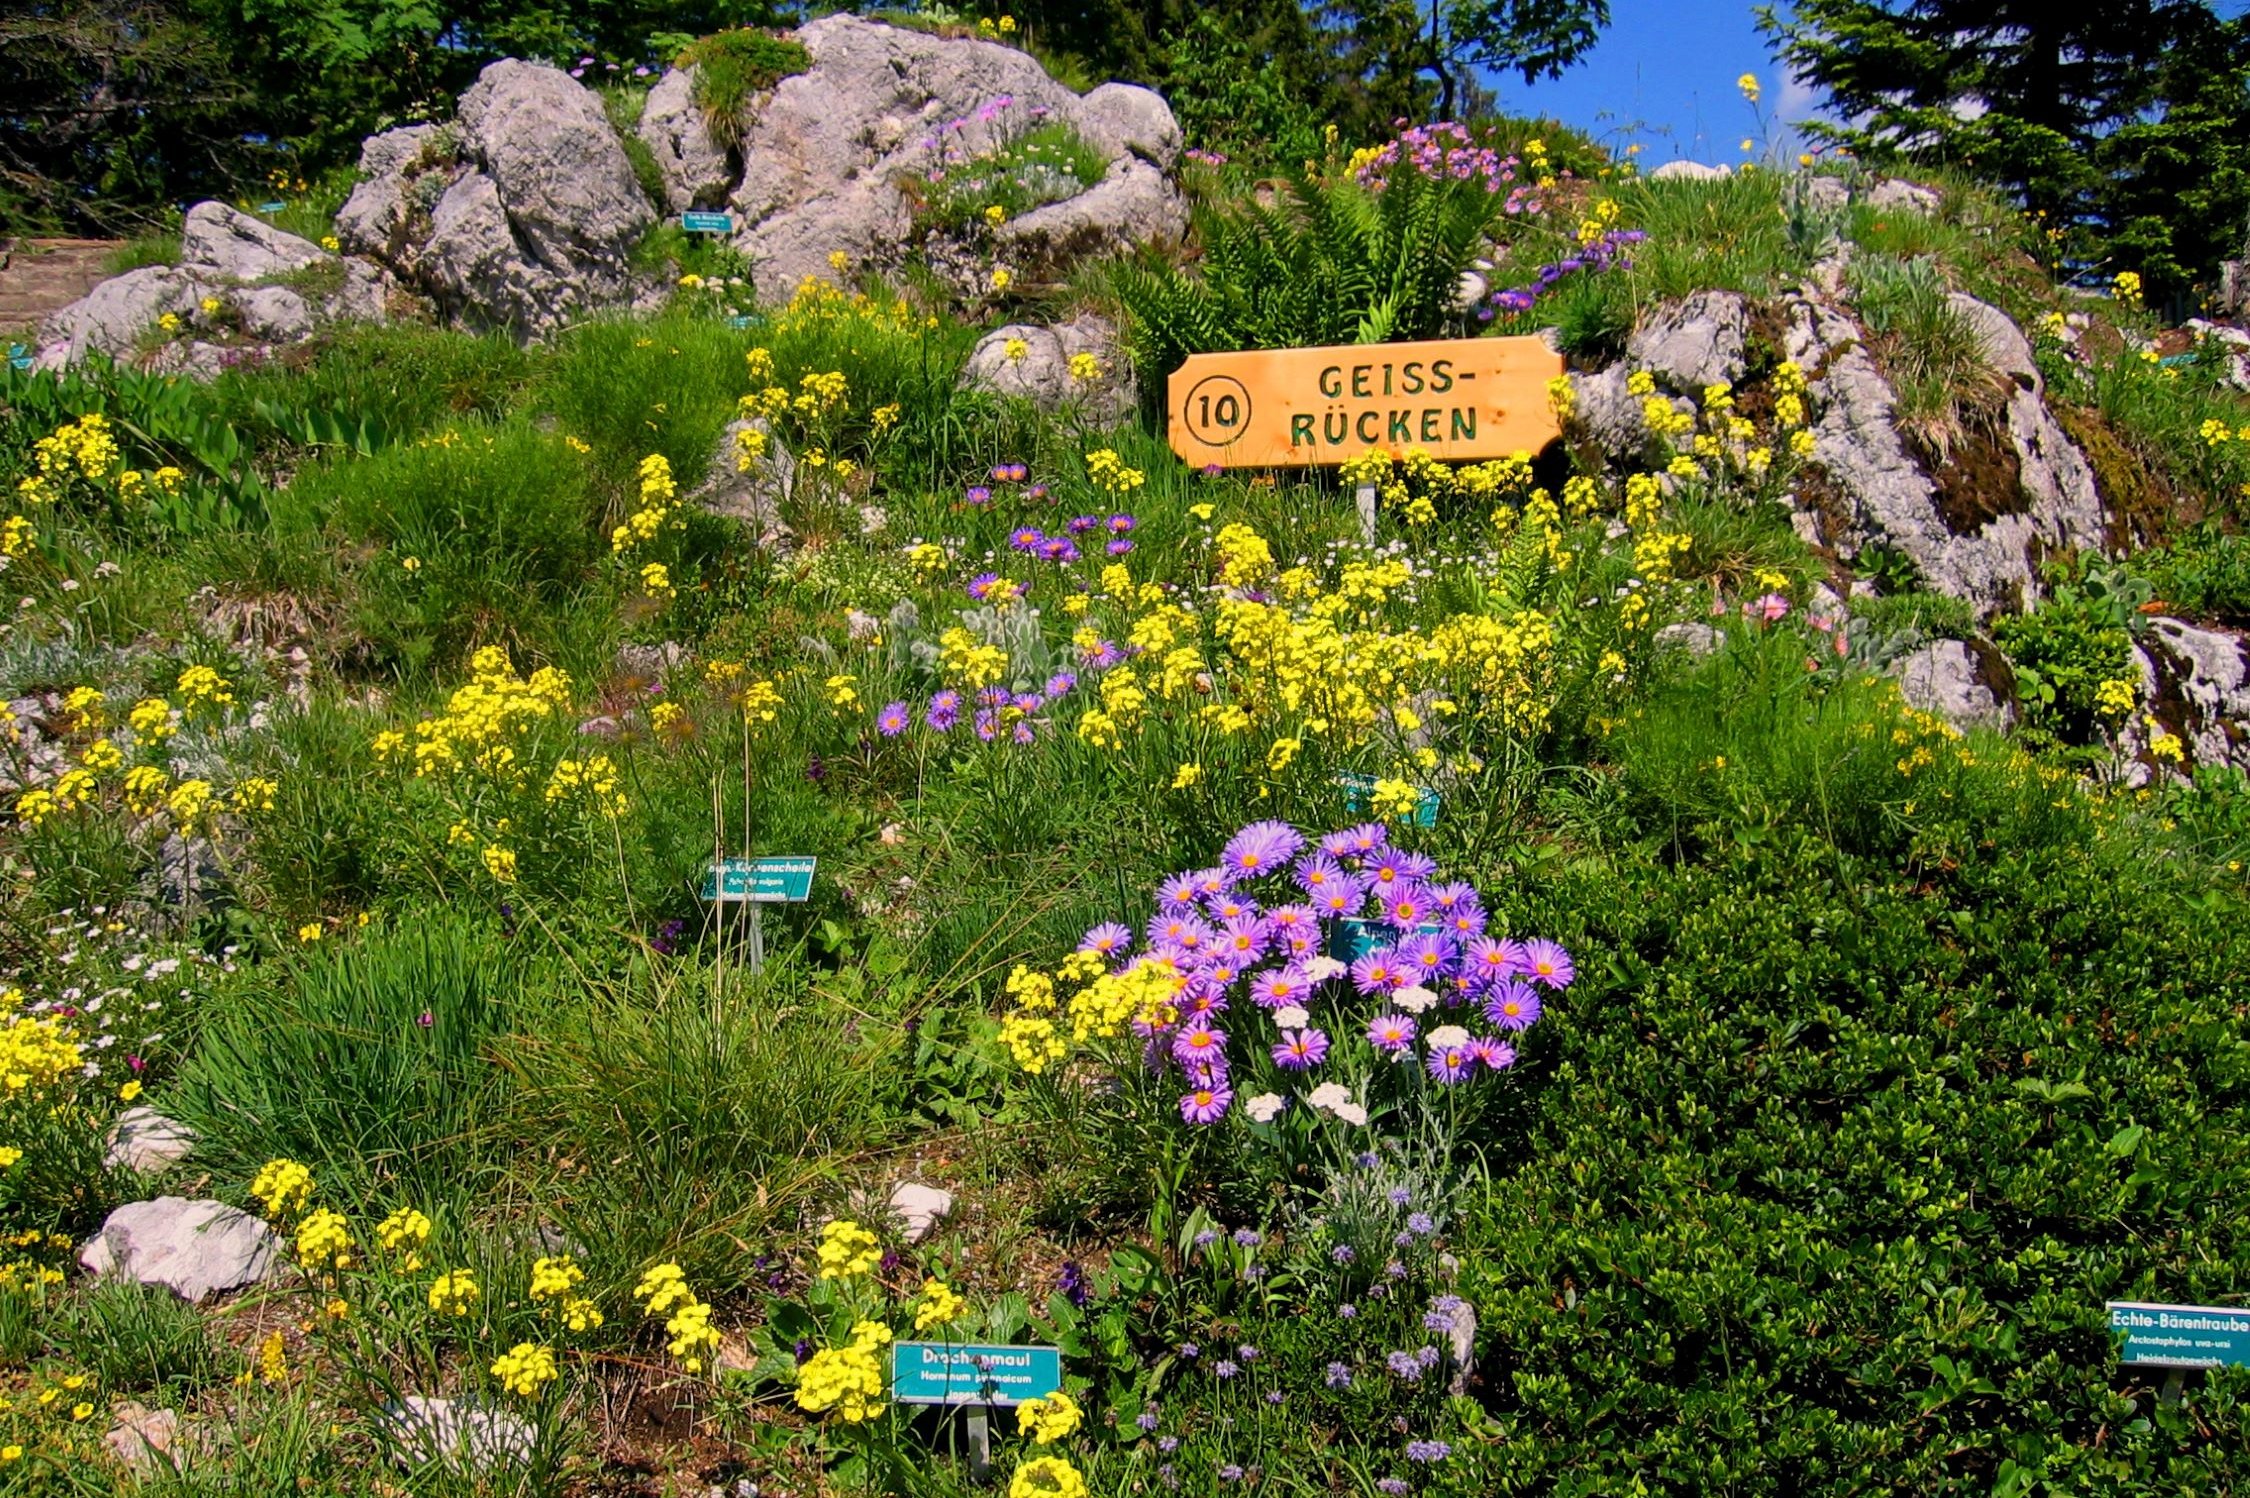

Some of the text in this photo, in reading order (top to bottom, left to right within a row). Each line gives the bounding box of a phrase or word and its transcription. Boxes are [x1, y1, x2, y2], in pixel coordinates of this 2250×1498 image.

[1319, 360, 1476, 398] GEISS-
[1198, 394, 1240, 428] 10
[1291, 404, 1477, 446] RÜCKEN
[2111, 1310, 2250, 1332] Echte-Bärentraube
[922, 1348, 1030, 1367] Drachnmaul
[921, 1370, 1032, 1384] Hormnum pynaicum
